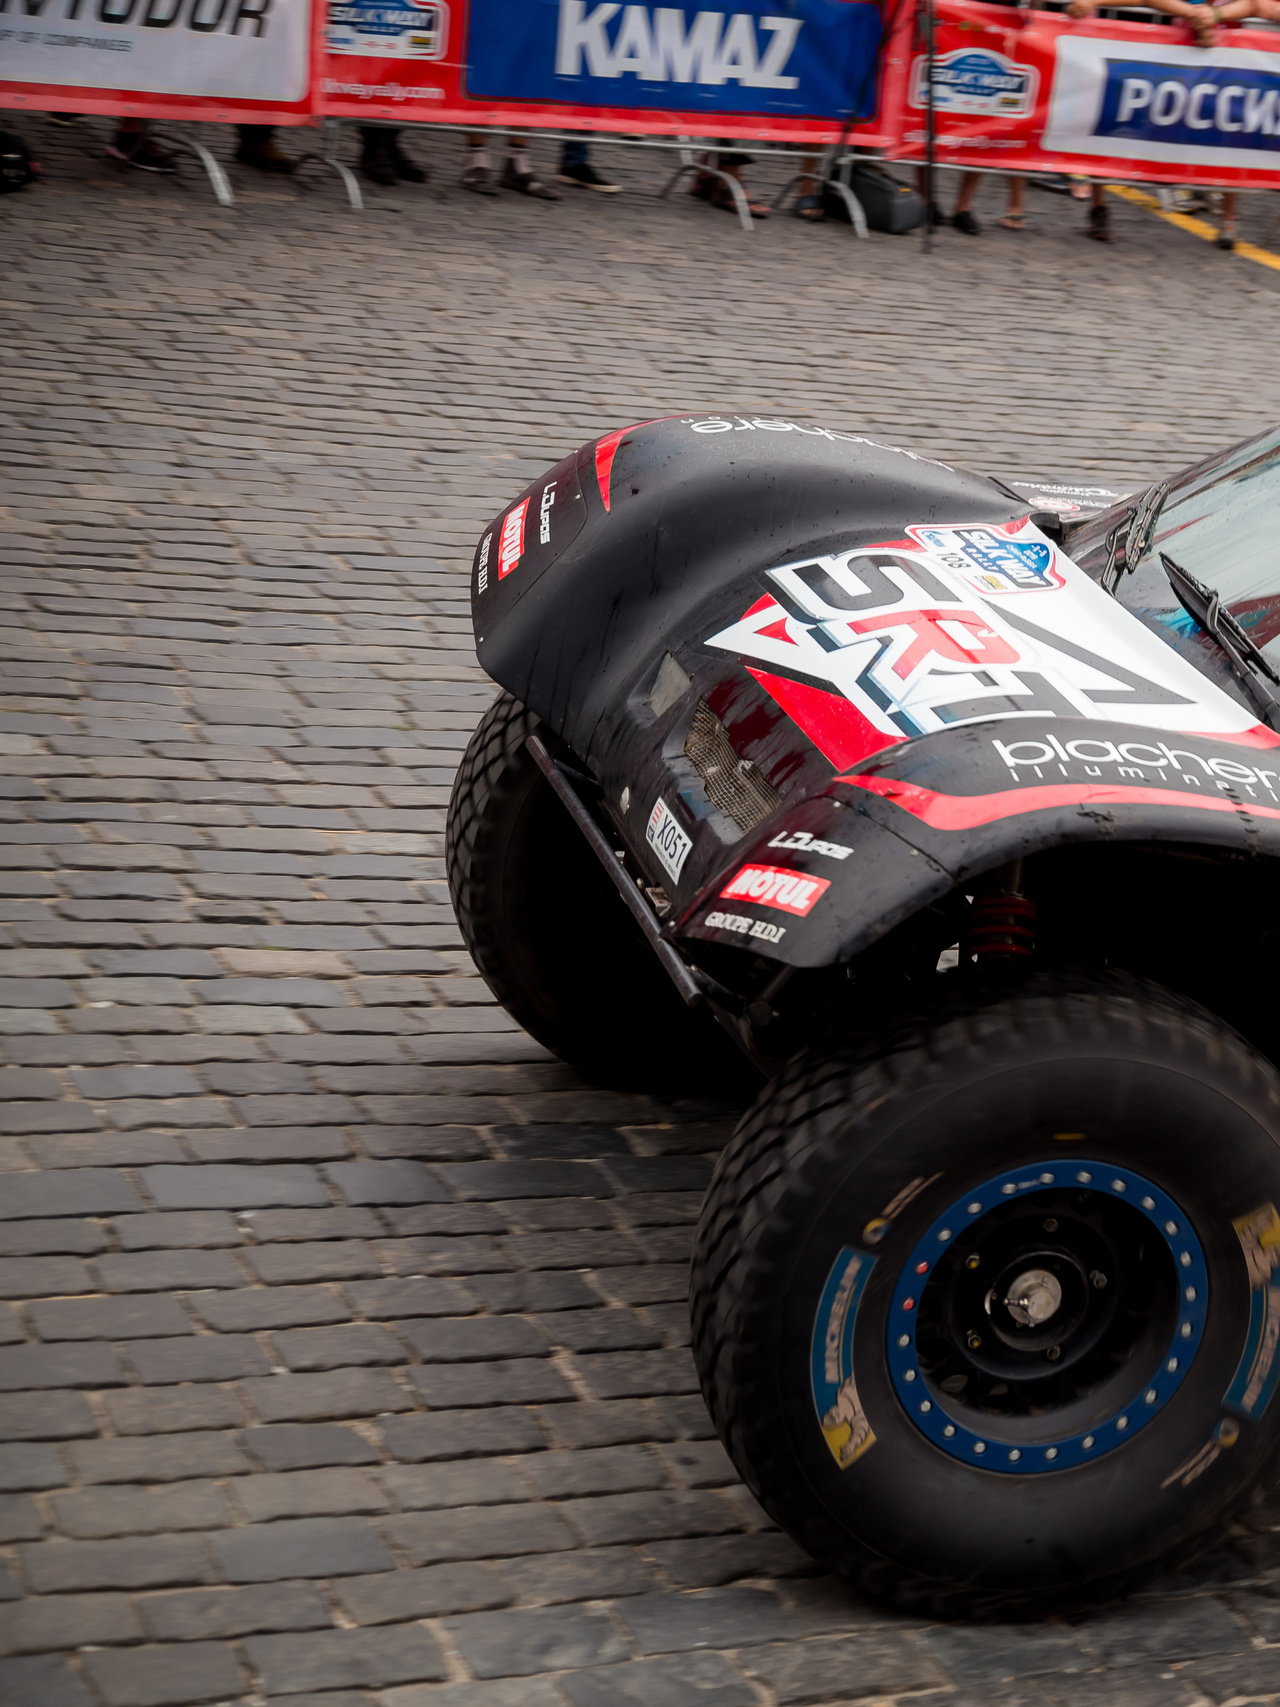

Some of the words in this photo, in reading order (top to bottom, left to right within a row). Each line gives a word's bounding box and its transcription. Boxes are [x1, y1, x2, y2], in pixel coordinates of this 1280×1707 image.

[554, 0, 805, 90] KAMAZ
[502, 503, 526, 574] MOTUL
[936, 552, 972, 569] 108
[959, 530, 1016, 559] SILK
[996, 557, 1048, 586] WAY
[965, 547, 1000, 572] RALLY
[656, 812, 689, 870] X051
[725, 868, 820, 911] MOTUL
[704, 911, 752, 935] GROUPE
[749, 919, 787, 944] HDI
